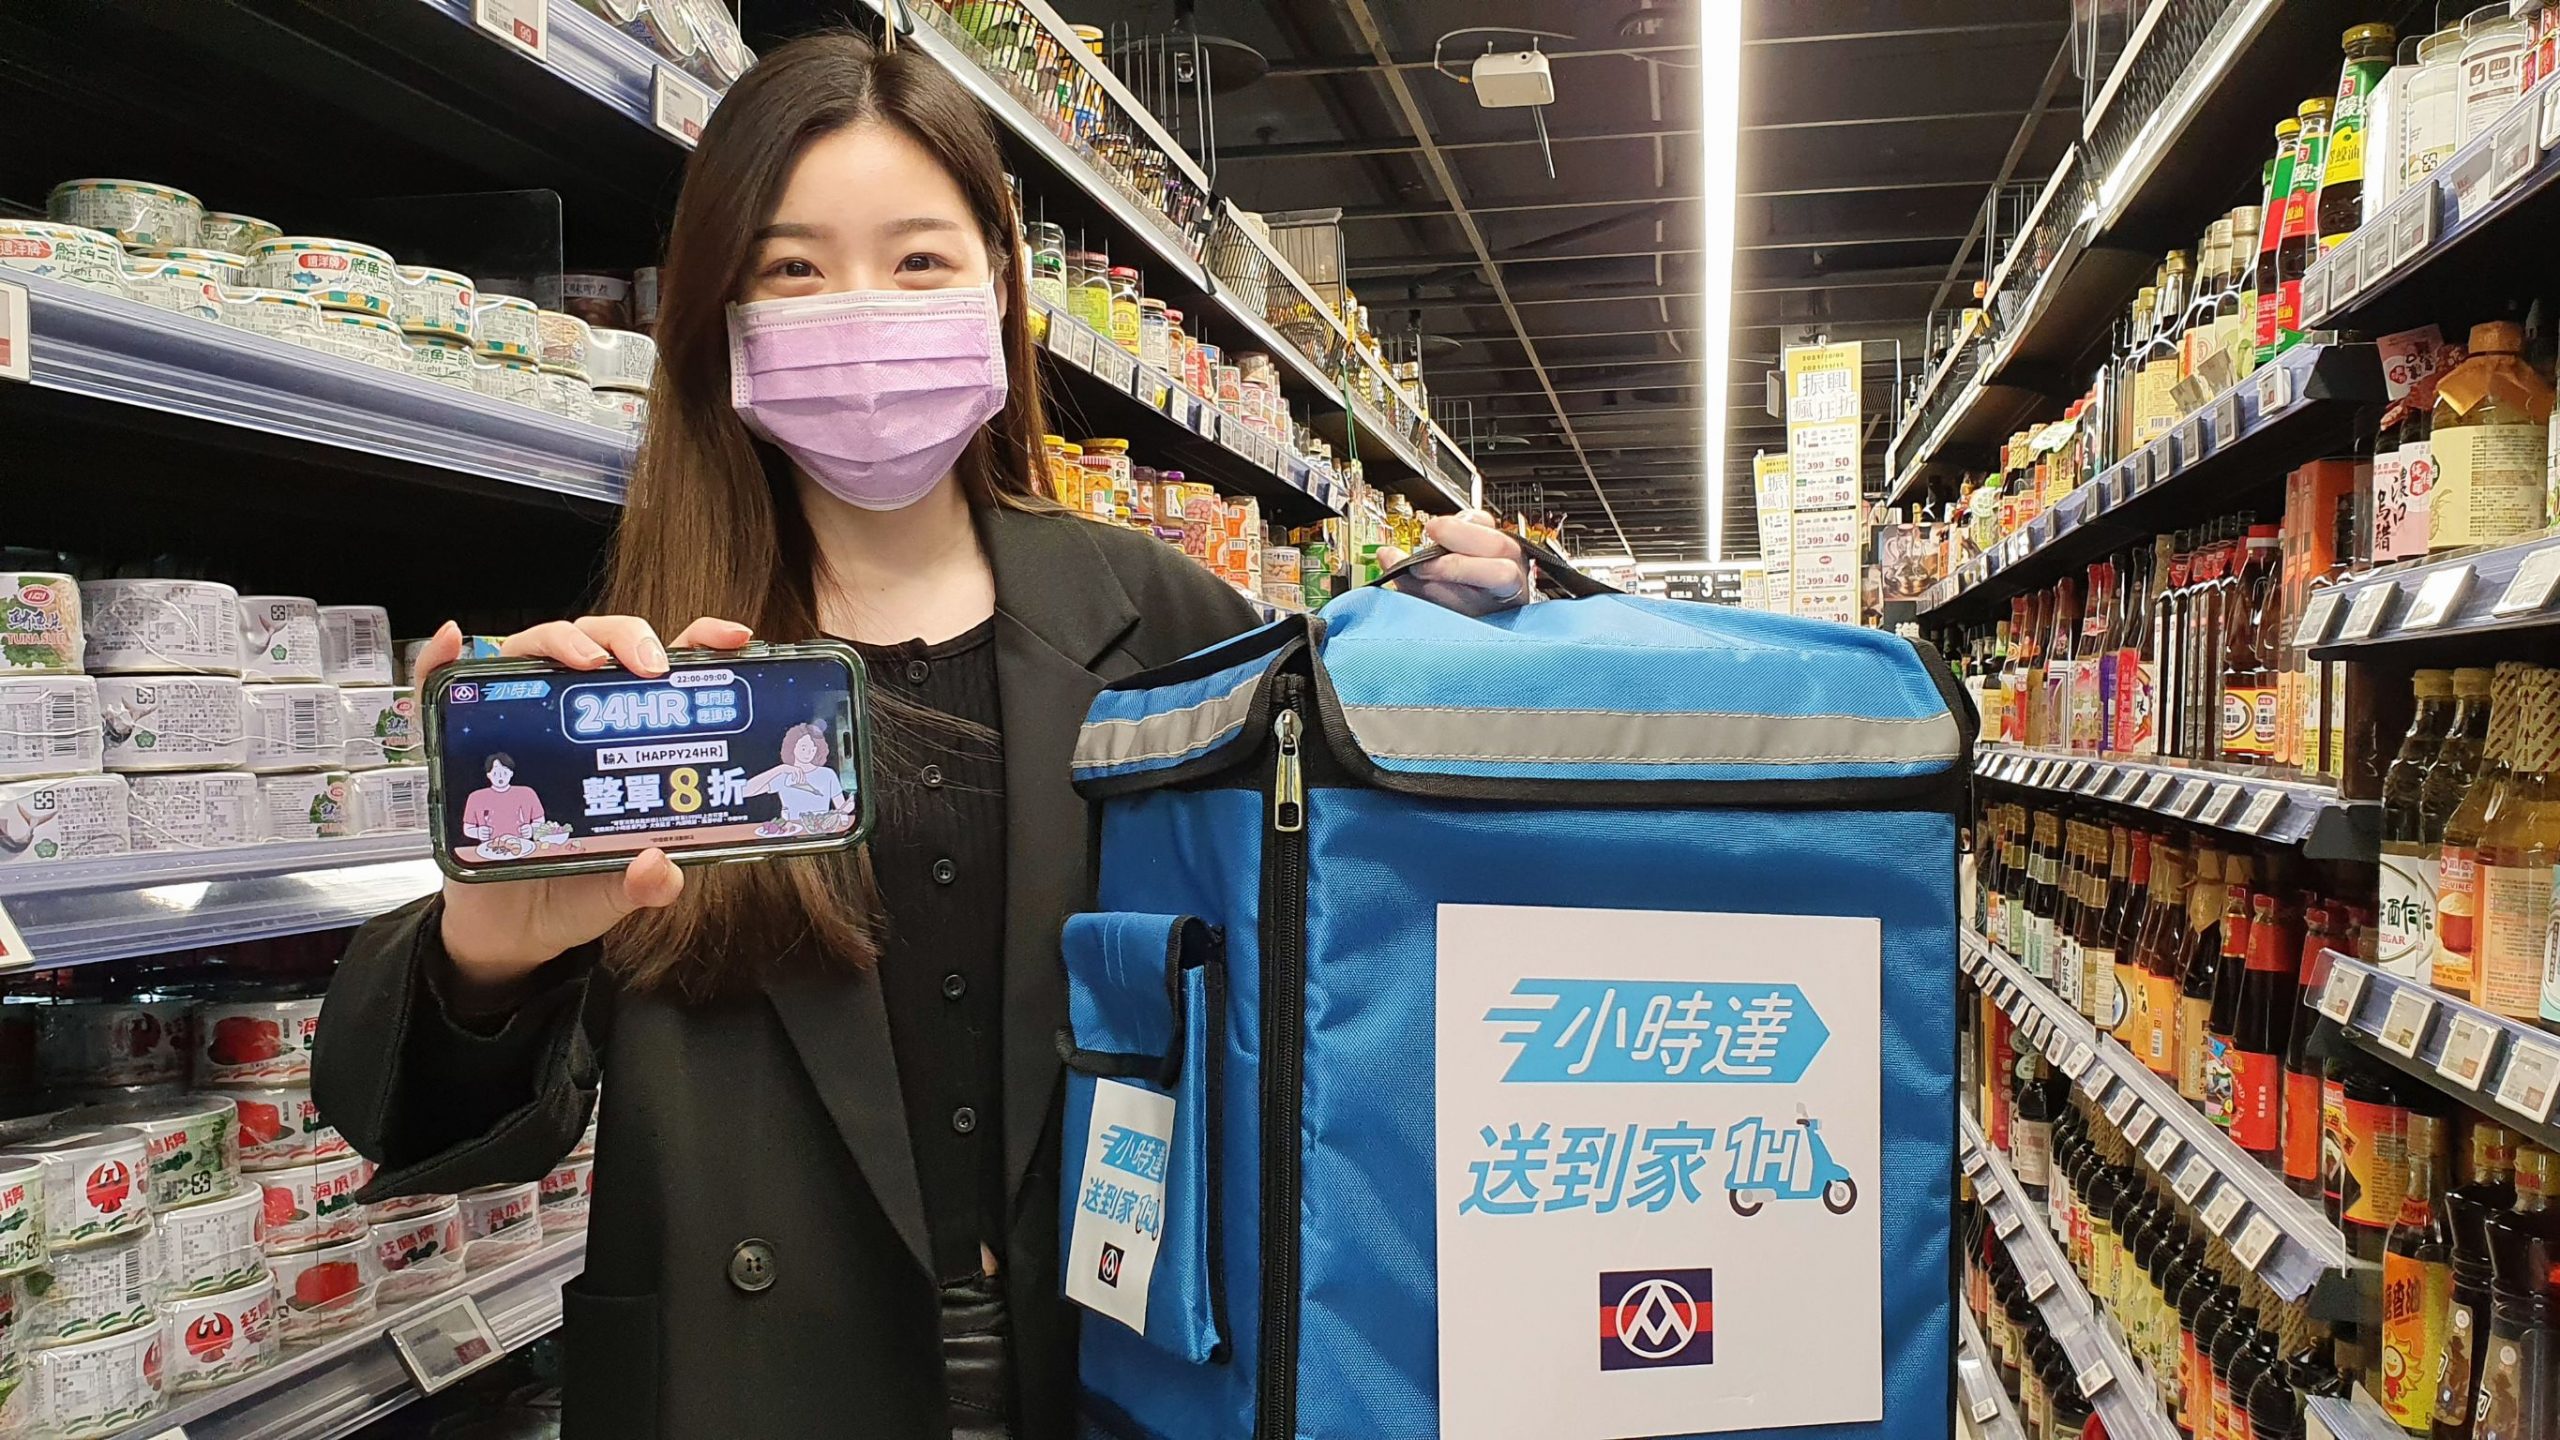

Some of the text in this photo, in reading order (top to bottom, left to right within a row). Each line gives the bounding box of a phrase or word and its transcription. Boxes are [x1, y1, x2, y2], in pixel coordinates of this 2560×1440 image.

[1803, 371, 1847, 397] 振興
[1834, 456, 1850, 468] 50
[1834, 490, 1850, 502] 50
[1834, 532, 1850, 543] 40
[1701, 575, 1713, 598] 3
[1834, 573, 1849, 583] 40
[494, 681, 543, 699] 小時達
[676, 673, 728, 684] 22:00-09:00
[575, 690, 690, 733] 24HR
[582, 766, 748, 814] 整單8折
[1553, 987, 1793, 1076] 小時達
[1115, 1133, 1167, 1181] 小時達
[1458, 1120, 1717, 1216] 送到家
[1081, 1177, 1138, 1225] 送到家
